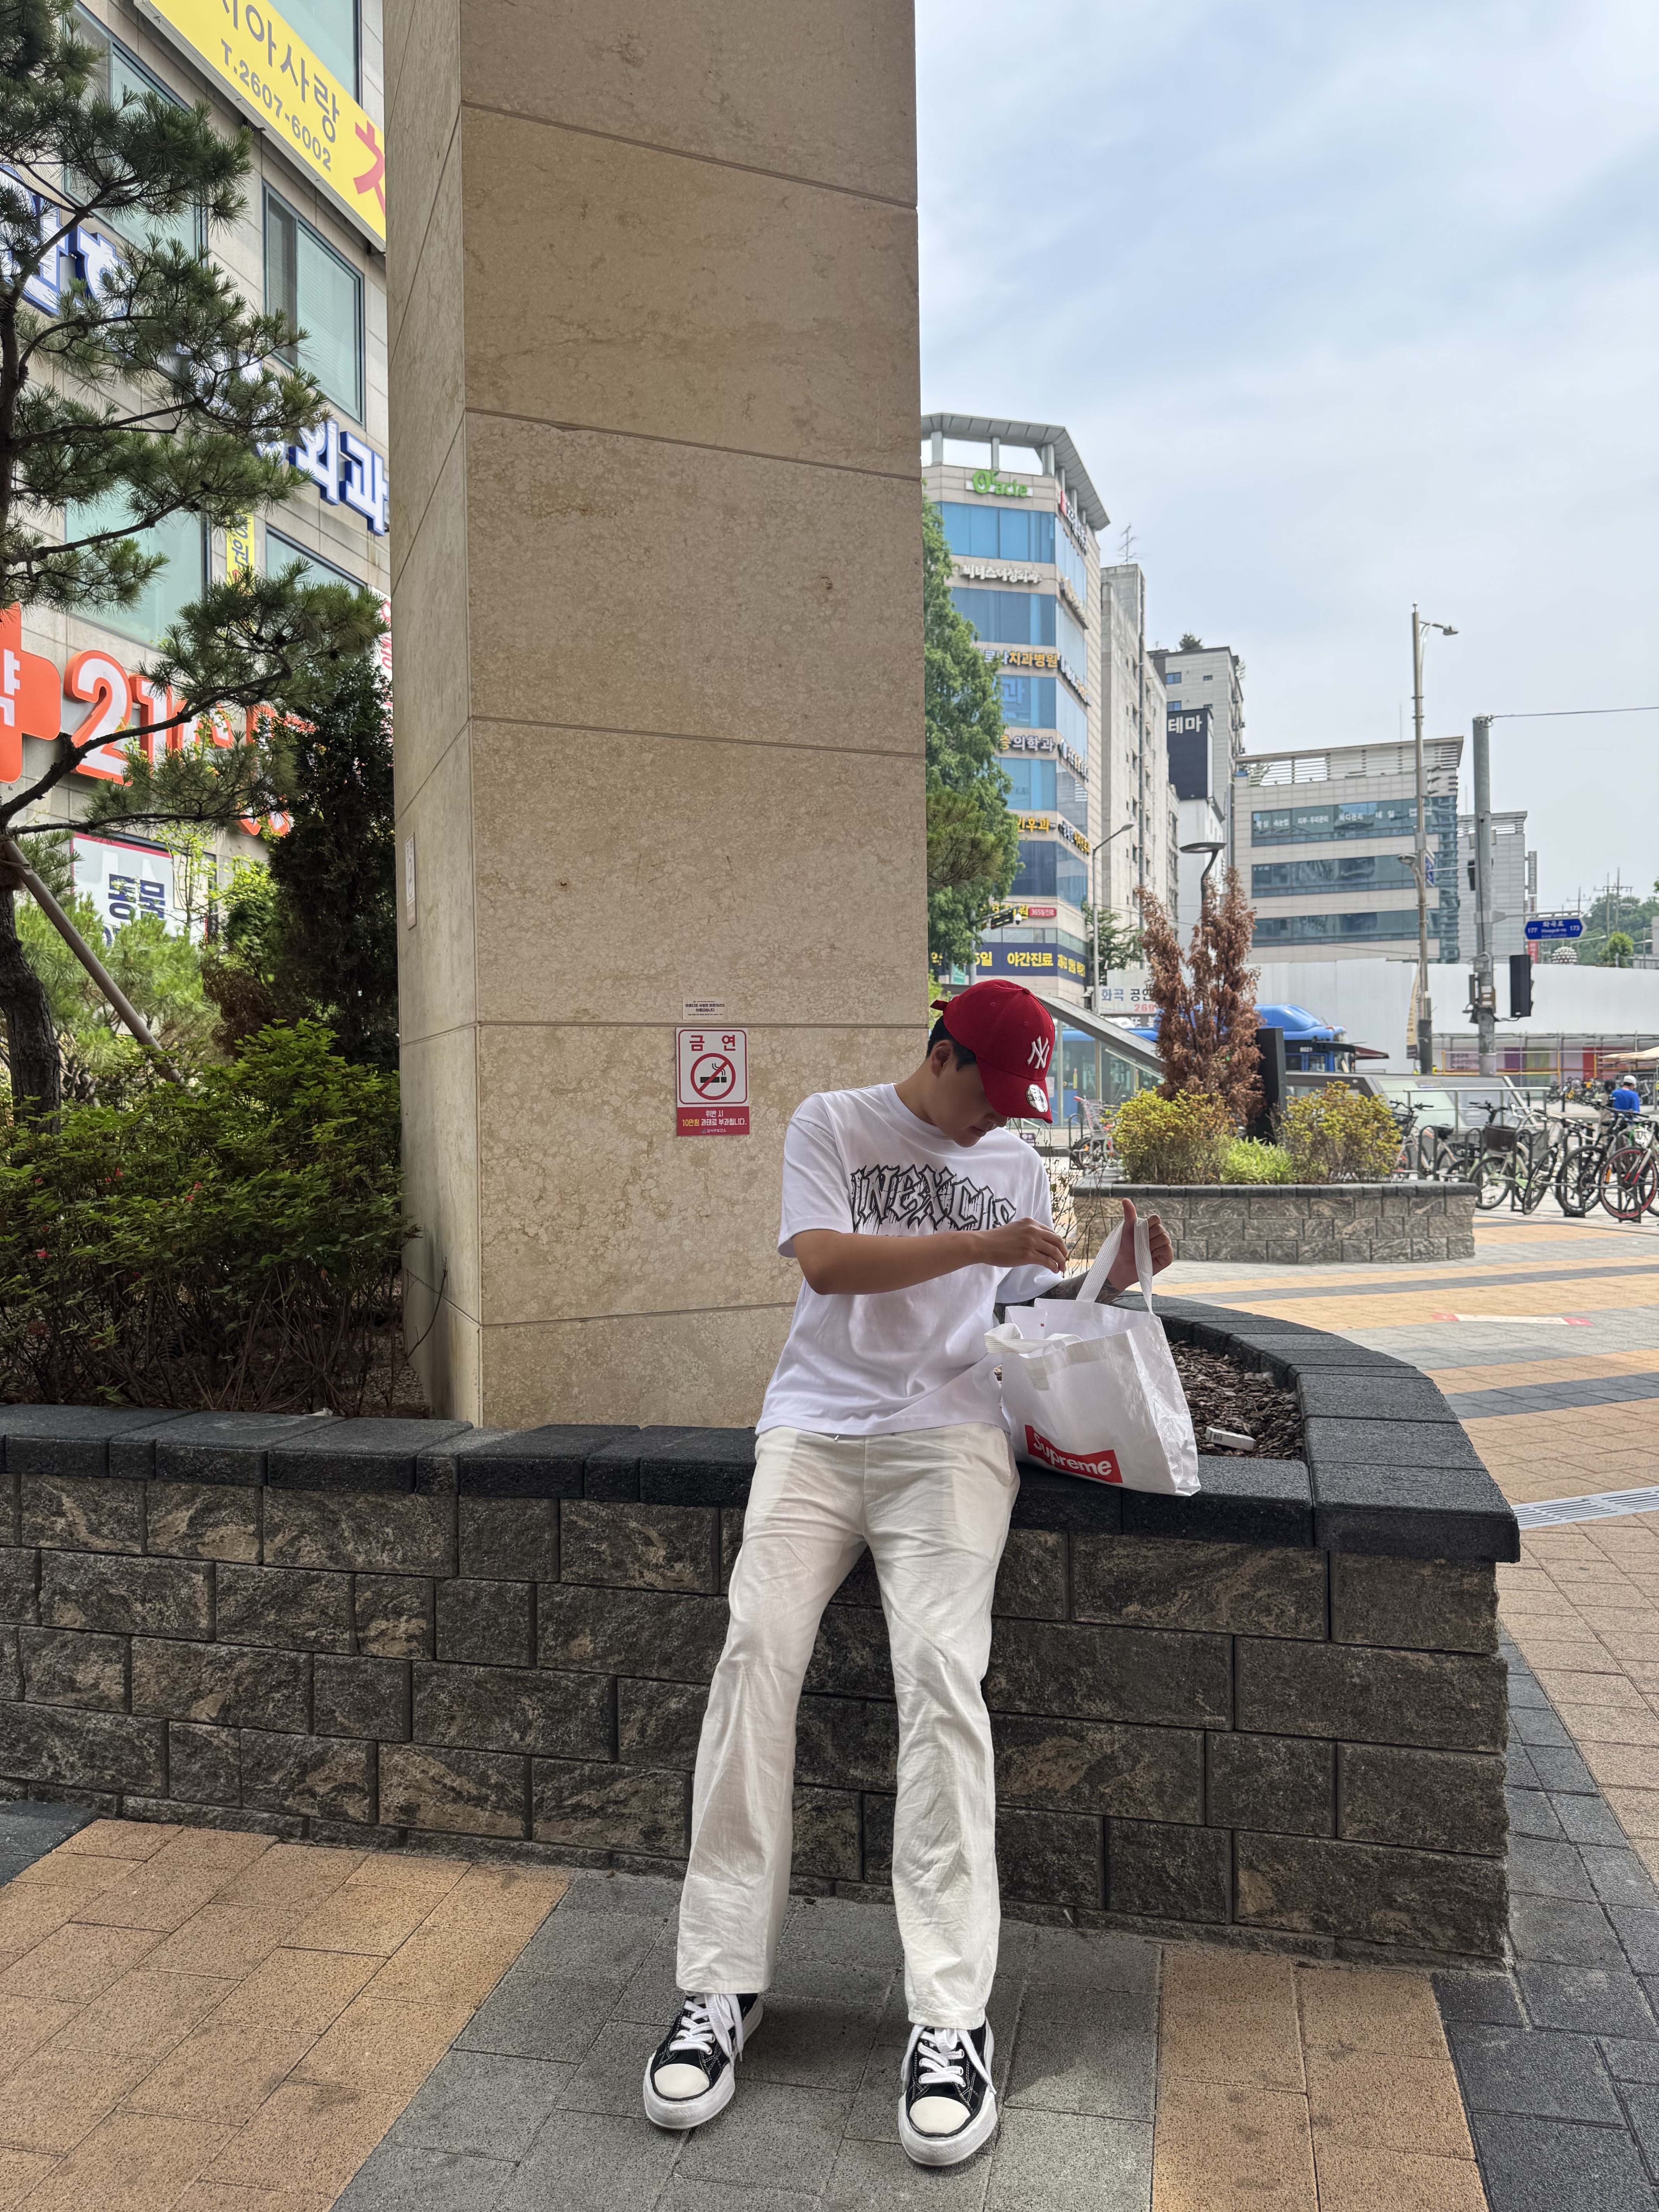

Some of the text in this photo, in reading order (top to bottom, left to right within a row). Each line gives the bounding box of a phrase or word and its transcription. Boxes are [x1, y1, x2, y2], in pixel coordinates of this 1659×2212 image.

[221, 38, 331, 172] T.2607-6002
[972, 469, 1027, 497] Oracle
[1168, 715, 1202, 734] 테마
[1007, 951, 1053, 967] 야간진료
[1101, 989, 1124, 1001] 화곡
[1027, 1036, 1050, 1069] NY
[1033, 1432, 1112, 1476] Supreme
